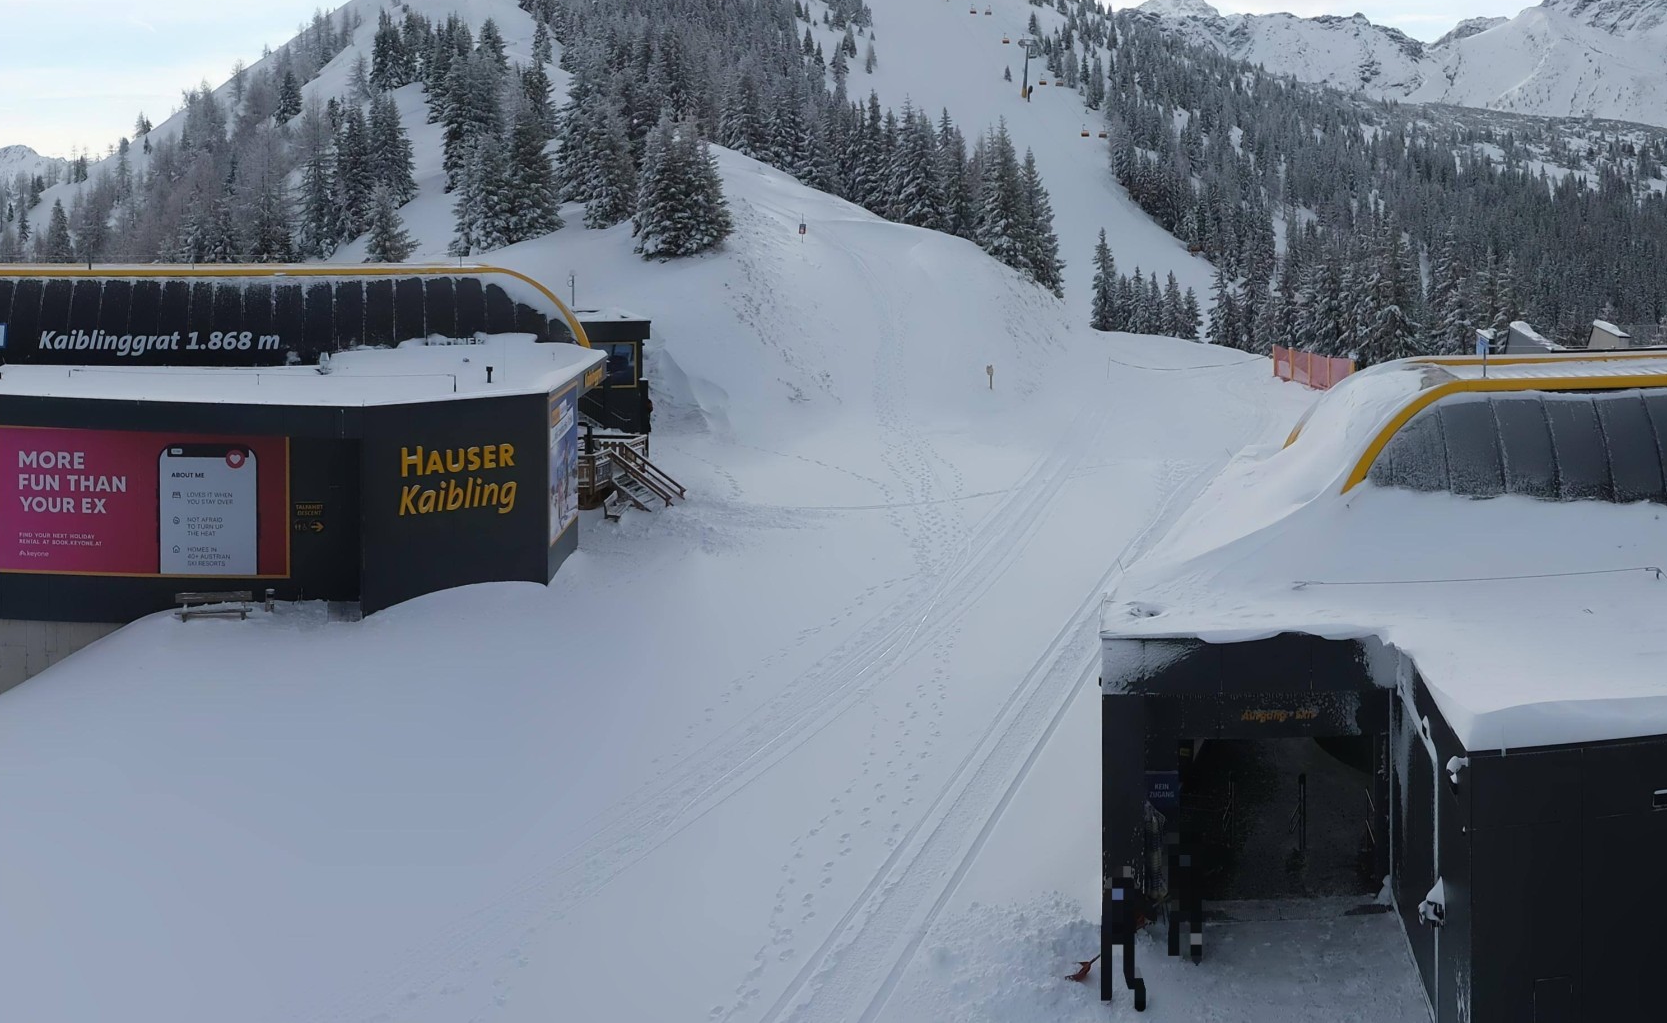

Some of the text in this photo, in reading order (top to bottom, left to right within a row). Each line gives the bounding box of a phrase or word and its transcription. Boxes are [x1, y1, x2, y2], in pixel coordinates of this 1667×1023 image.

[38, 329, 280, 356] Kaiblinggrat 1.868 m
[18, 450, 85, 469] MORE
[401, 443, 515, 477] HAUSER
[18, 474, 127, 493] FUN THAN
[19, 496, 107, 514] YOUR EX
[399, 477, 518, 516] Kaibling
[26, 550, 50, 558] keyone
